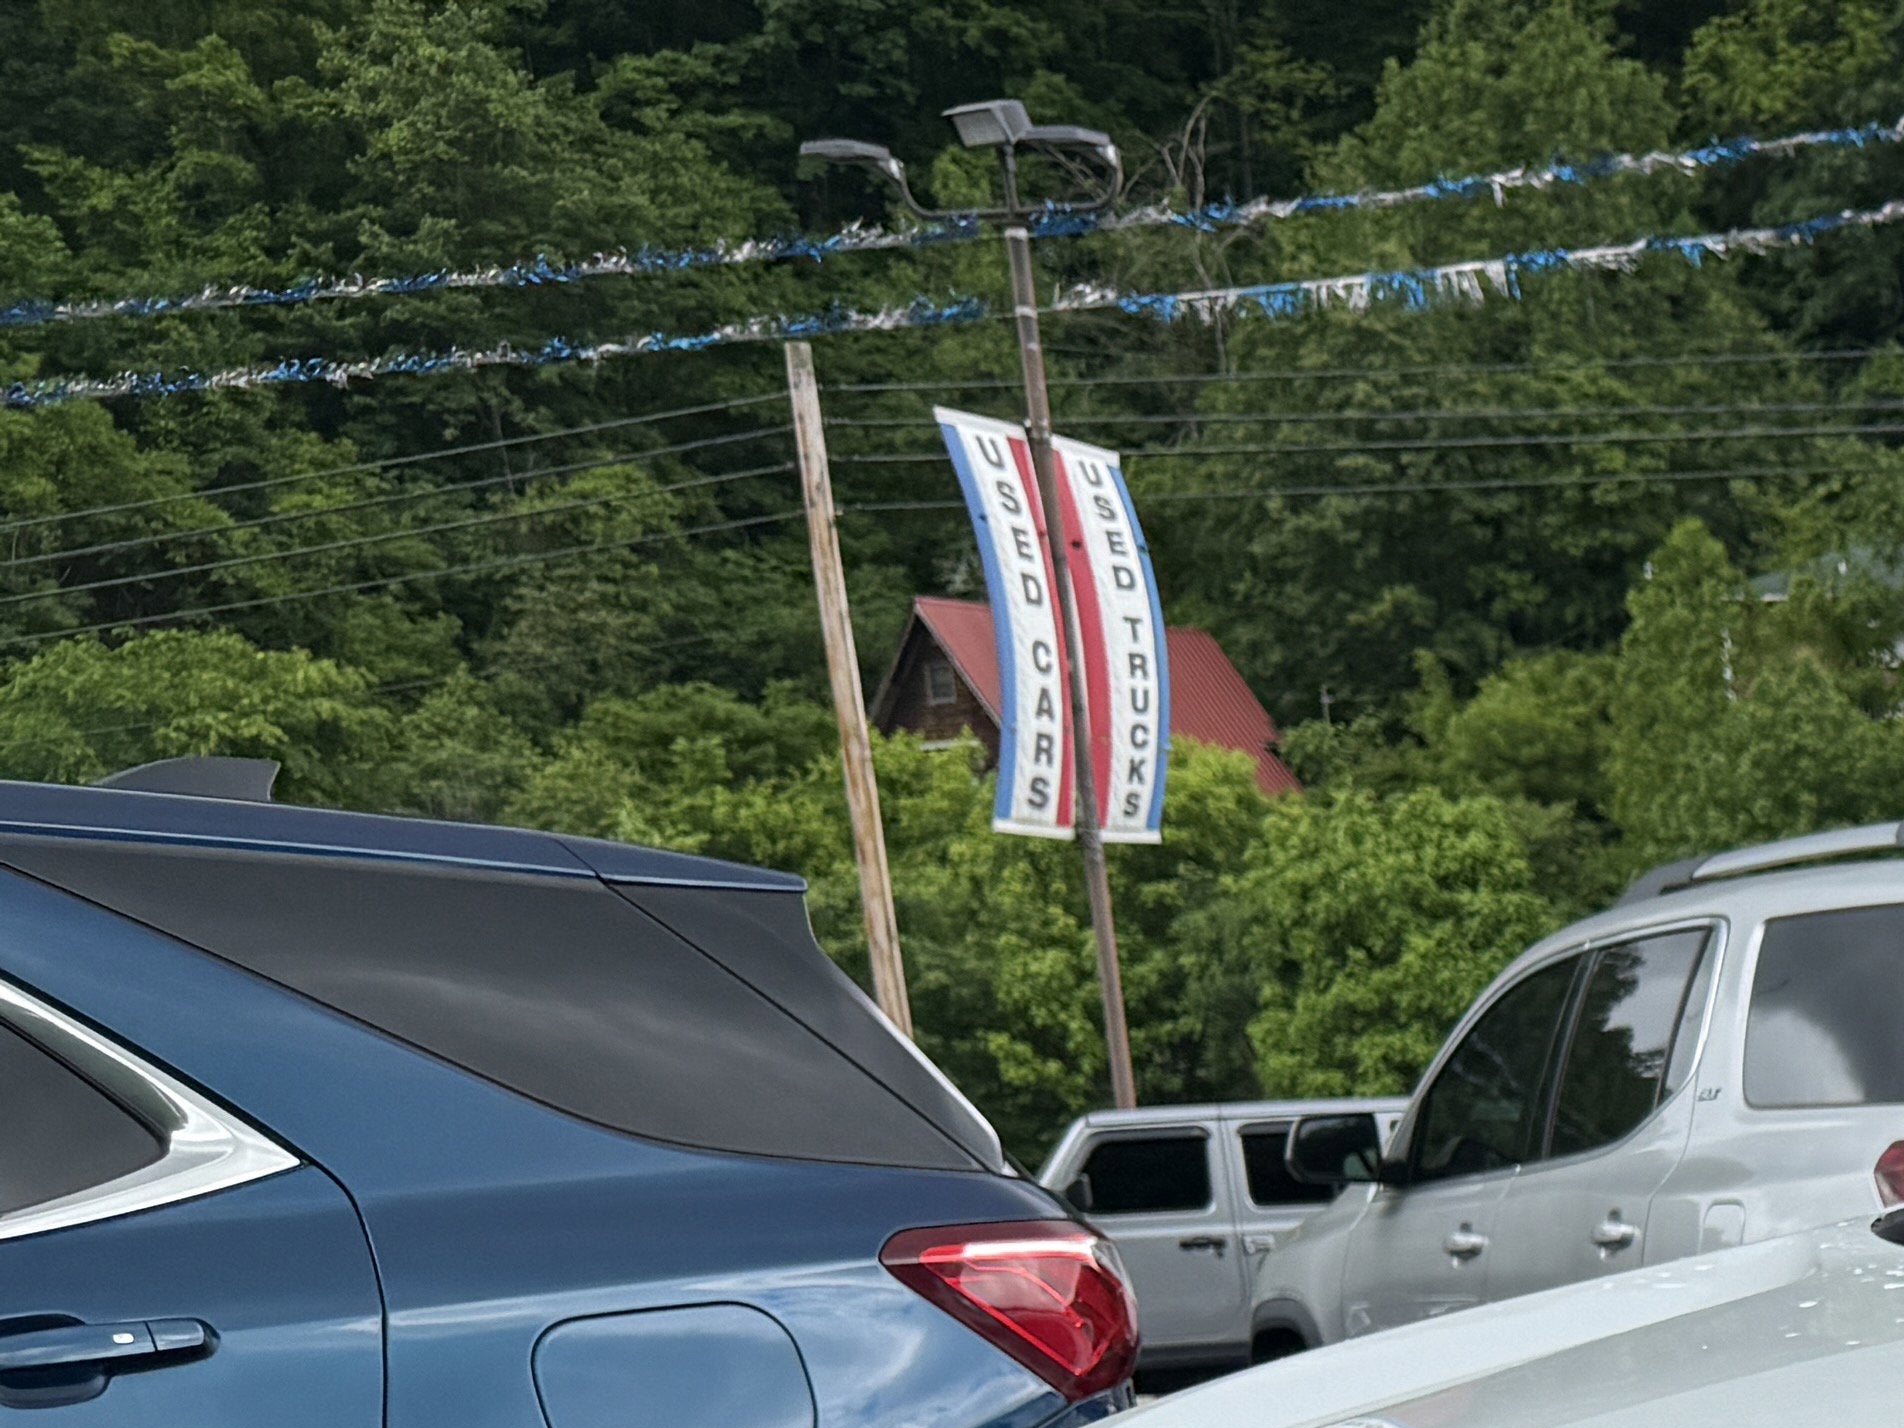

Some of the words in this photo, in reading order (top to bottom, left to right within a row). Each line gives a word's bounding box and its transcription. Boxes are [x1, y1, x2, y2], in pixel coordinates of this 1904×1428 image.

[976, 434, 1041, 606] USED
[1027, 641, 1055, 811] CARS
[1078, 460, 1136, 592] USED
[1123, 616, 1151, 818] TRUCKS
